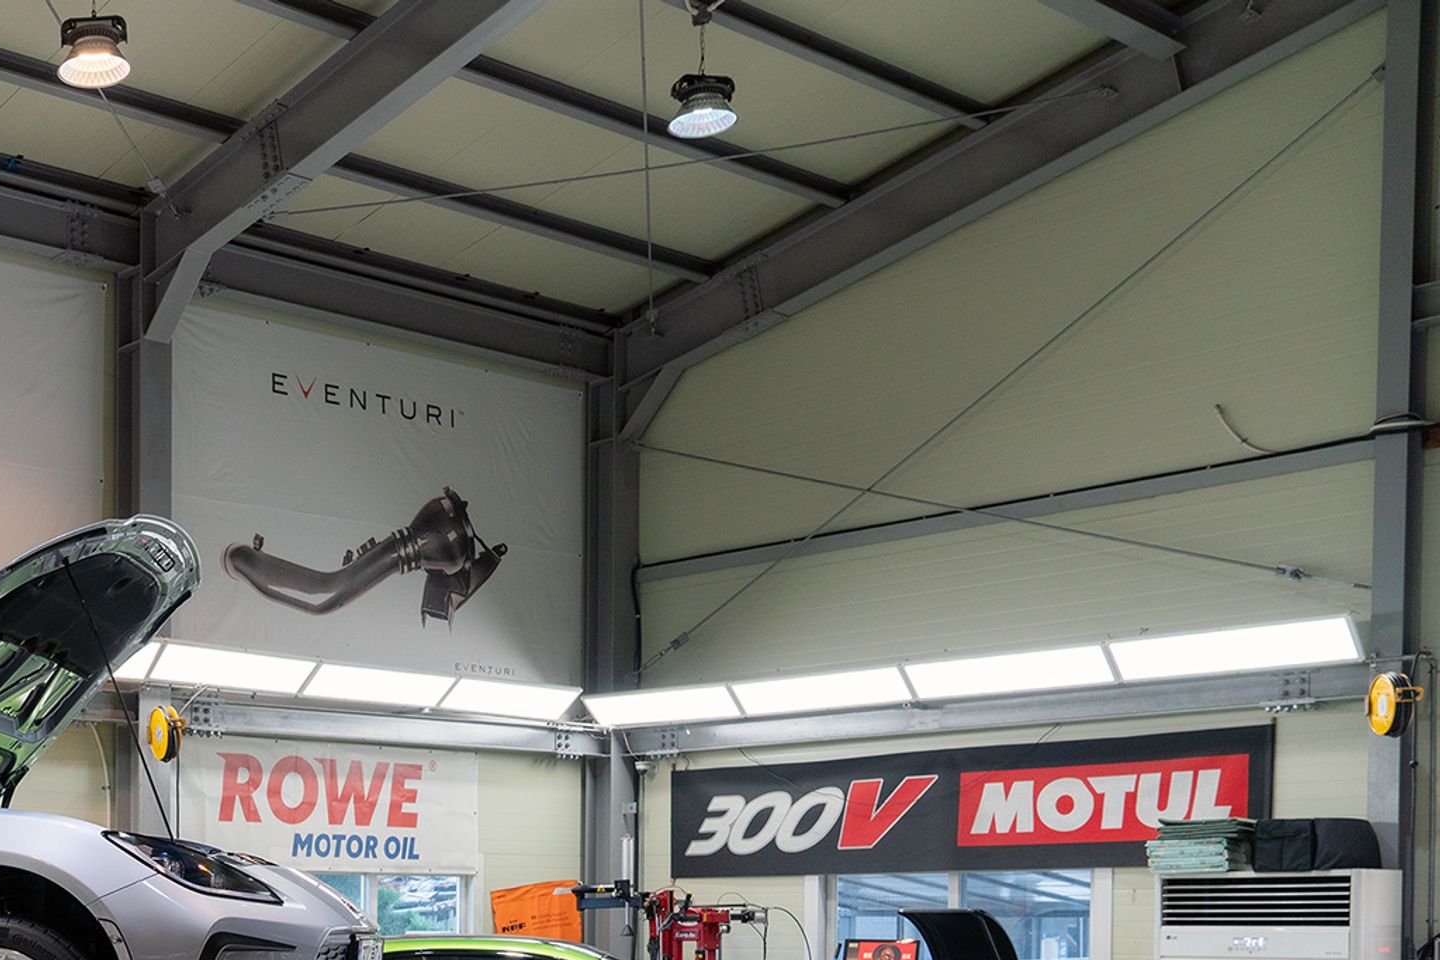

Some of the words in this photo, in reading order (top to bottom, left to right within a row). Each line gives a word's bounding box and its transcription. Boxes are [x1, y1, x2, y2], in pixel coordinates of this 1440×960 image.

[271, 371, 456, 428] EVENTURI
[454, 662, 516, 676] EVENTURI
[216, 752, 424, 829] ROWE
[685, 774, 939, 857] 300V
[970, 769, 1233, 834] MOTUL
[292, 832, 378, 859] MOTOR
[383, 835, 420, 861] OIL
